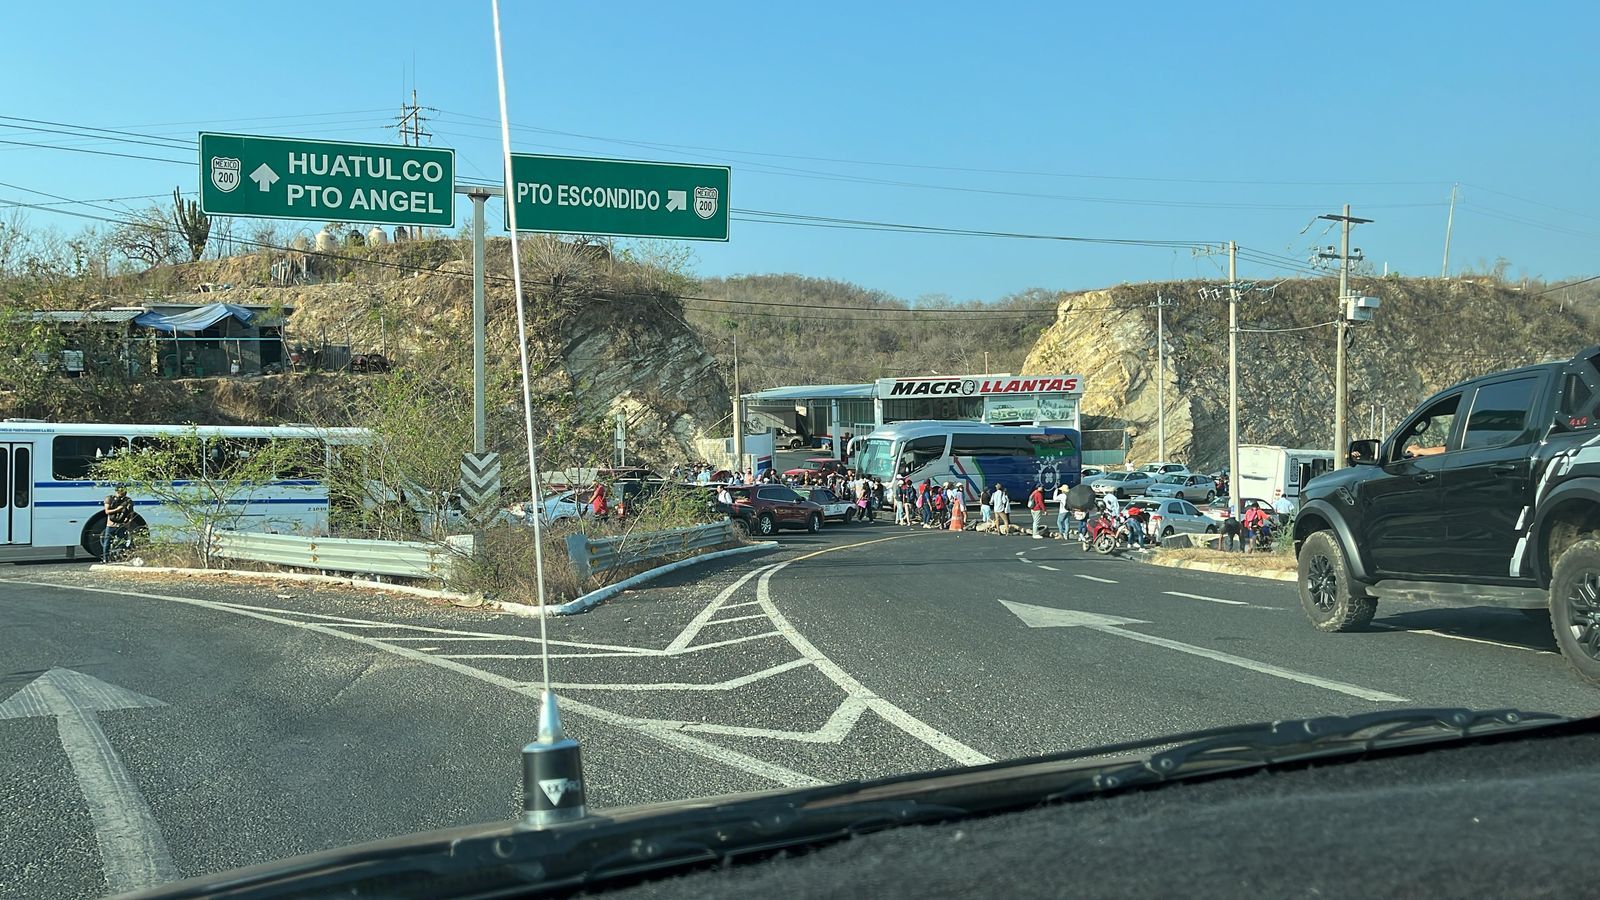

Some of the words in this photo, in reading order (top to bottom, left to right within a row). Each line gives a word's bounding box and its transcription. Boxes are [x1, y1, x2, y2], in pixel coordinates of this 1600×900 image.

[215, 160, 237, 169] MEXICO
[288, 152, 443, 182] HUATULCO
[218, 171, 234, 183] 200
[287, 184, 343, 208] PTO
[349, 188, 443, 214] ANGEL
[517, 182, 553, 205] PTO
[557, 184, 660, 211] ESCONDIDO
[699, 200, 713, 211] 200
[980, 378, 1078, 393] LLANTAS
